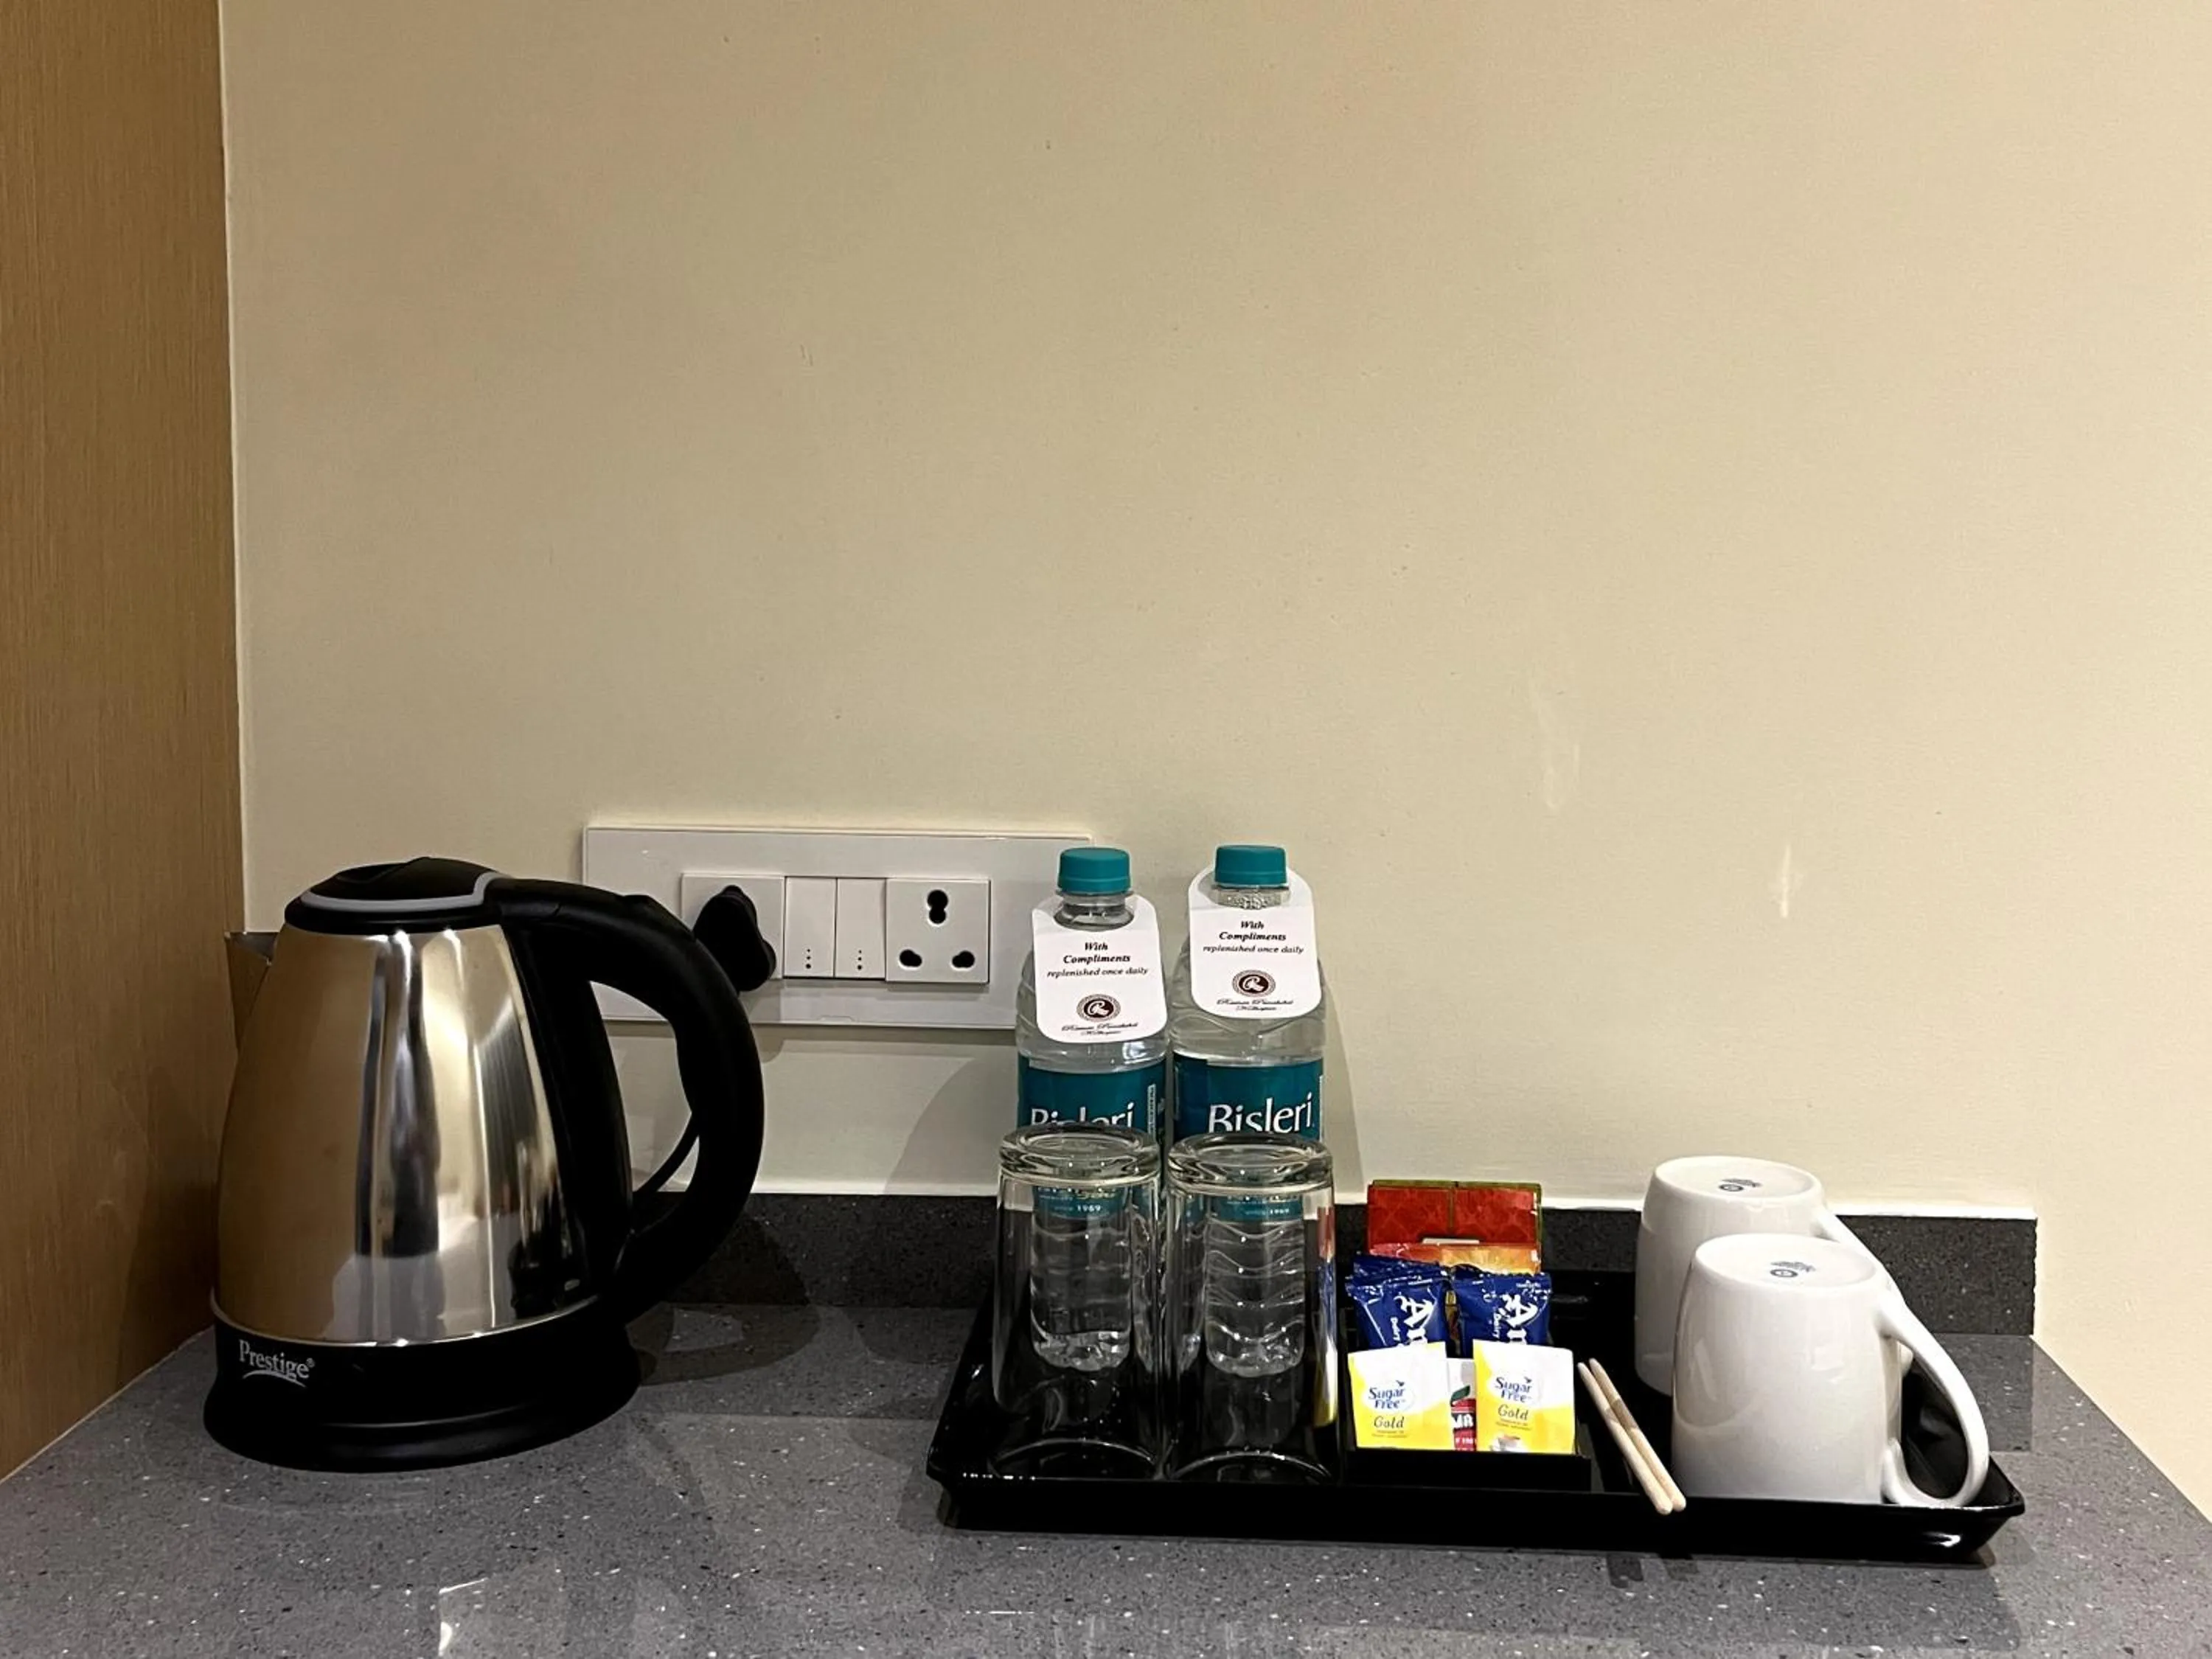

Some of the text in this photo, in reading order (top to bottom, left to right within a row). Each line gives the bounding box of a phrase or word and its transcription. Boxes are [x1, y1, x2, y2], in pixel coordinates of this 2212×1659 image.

[1241, 921, 1265, 929] With
[1219, 932, 1287, 942] Compliments
[1085, 942, 1108, 951] With
[1062, 955, 1130, 964] Compliments
[1208, 1091, 1312, 1134] Bisleri
[239, 1339, 310, 1380] Prestige
[1495, 1377, 1532, 1394] Sugar
[1368, 1387, 1405, 1400] Sugar
[1501, 1389, 1528, 1402] Free
[1374, 1398, 1400, 1409] Free
[1498, 1404, 1528, 1421] Gold
[1374, 1415, 1405, 1428] Gold
